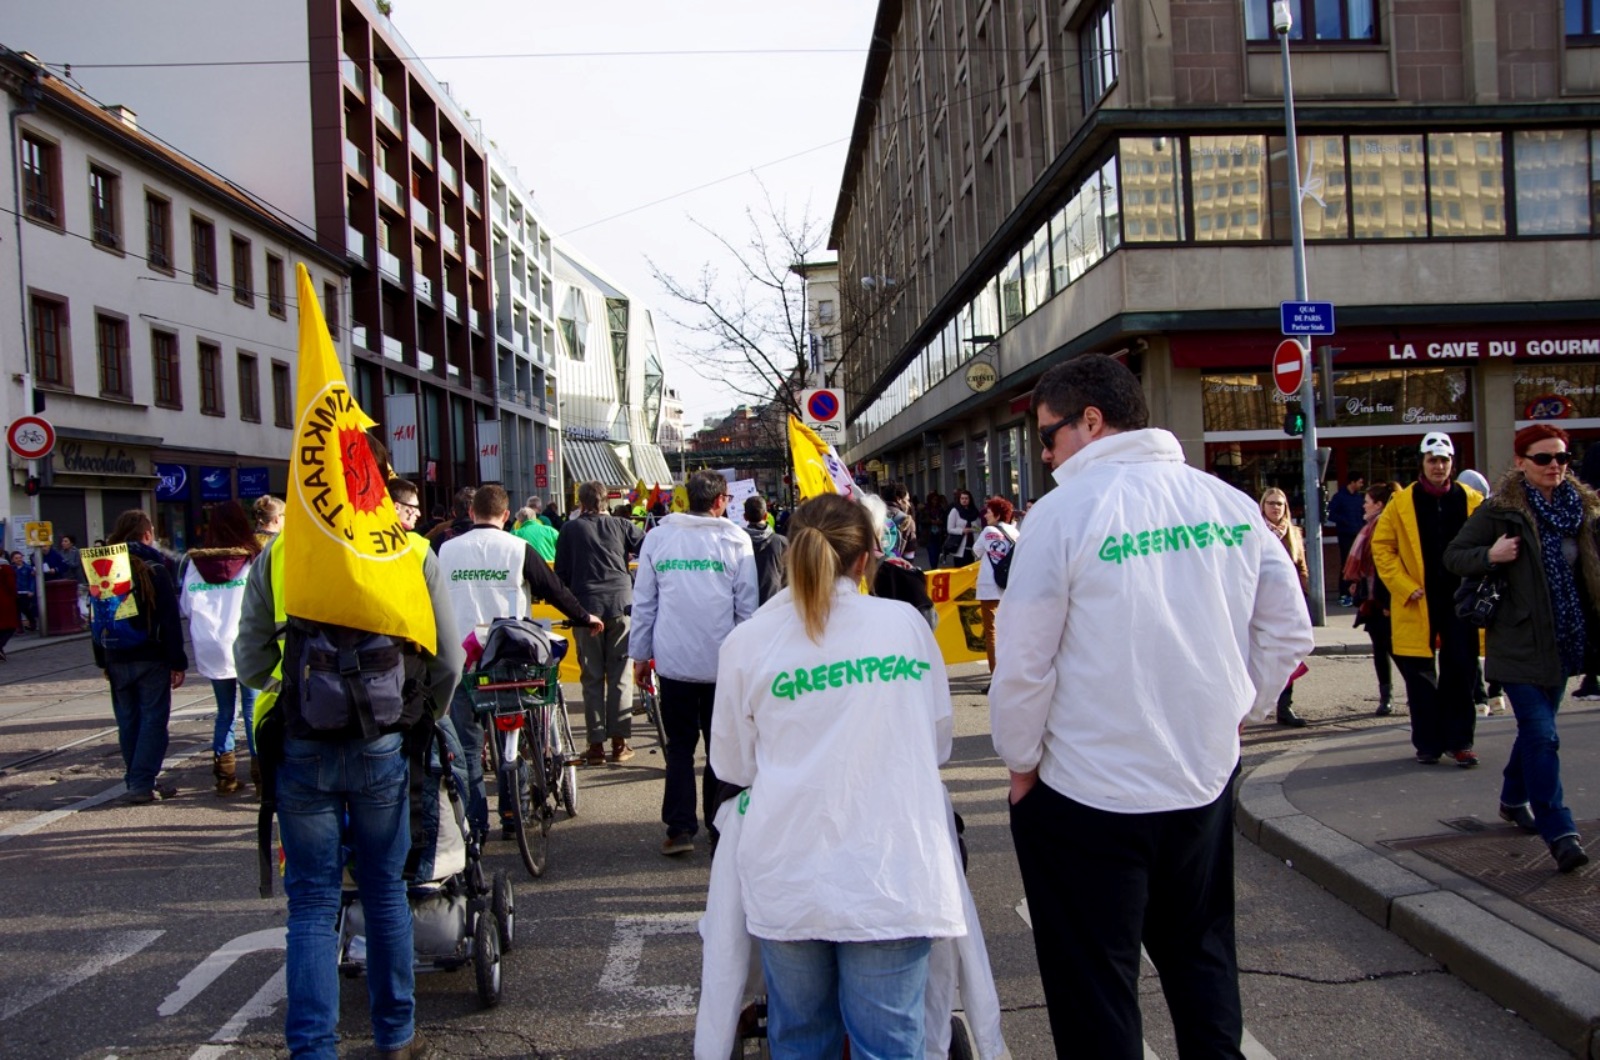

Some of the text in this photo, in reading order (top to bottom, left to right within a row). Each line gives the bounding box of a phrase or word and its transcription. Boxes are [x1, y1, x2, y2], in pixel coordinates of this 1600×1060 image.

[1299, 305, 1316, 314] QUAI
[1294, 314, 1322, 322] DE PARIS
[1388, 344, 1417, 360] LA
[1427, 341, 1480, 358] CAVE
[1488, 340, 1516, 357] DU
[1376, 402, 1394, 414] fins
[61, 440, 137, 474] Chocolatier
[450, 569, 510, 582] GREENPEACE
